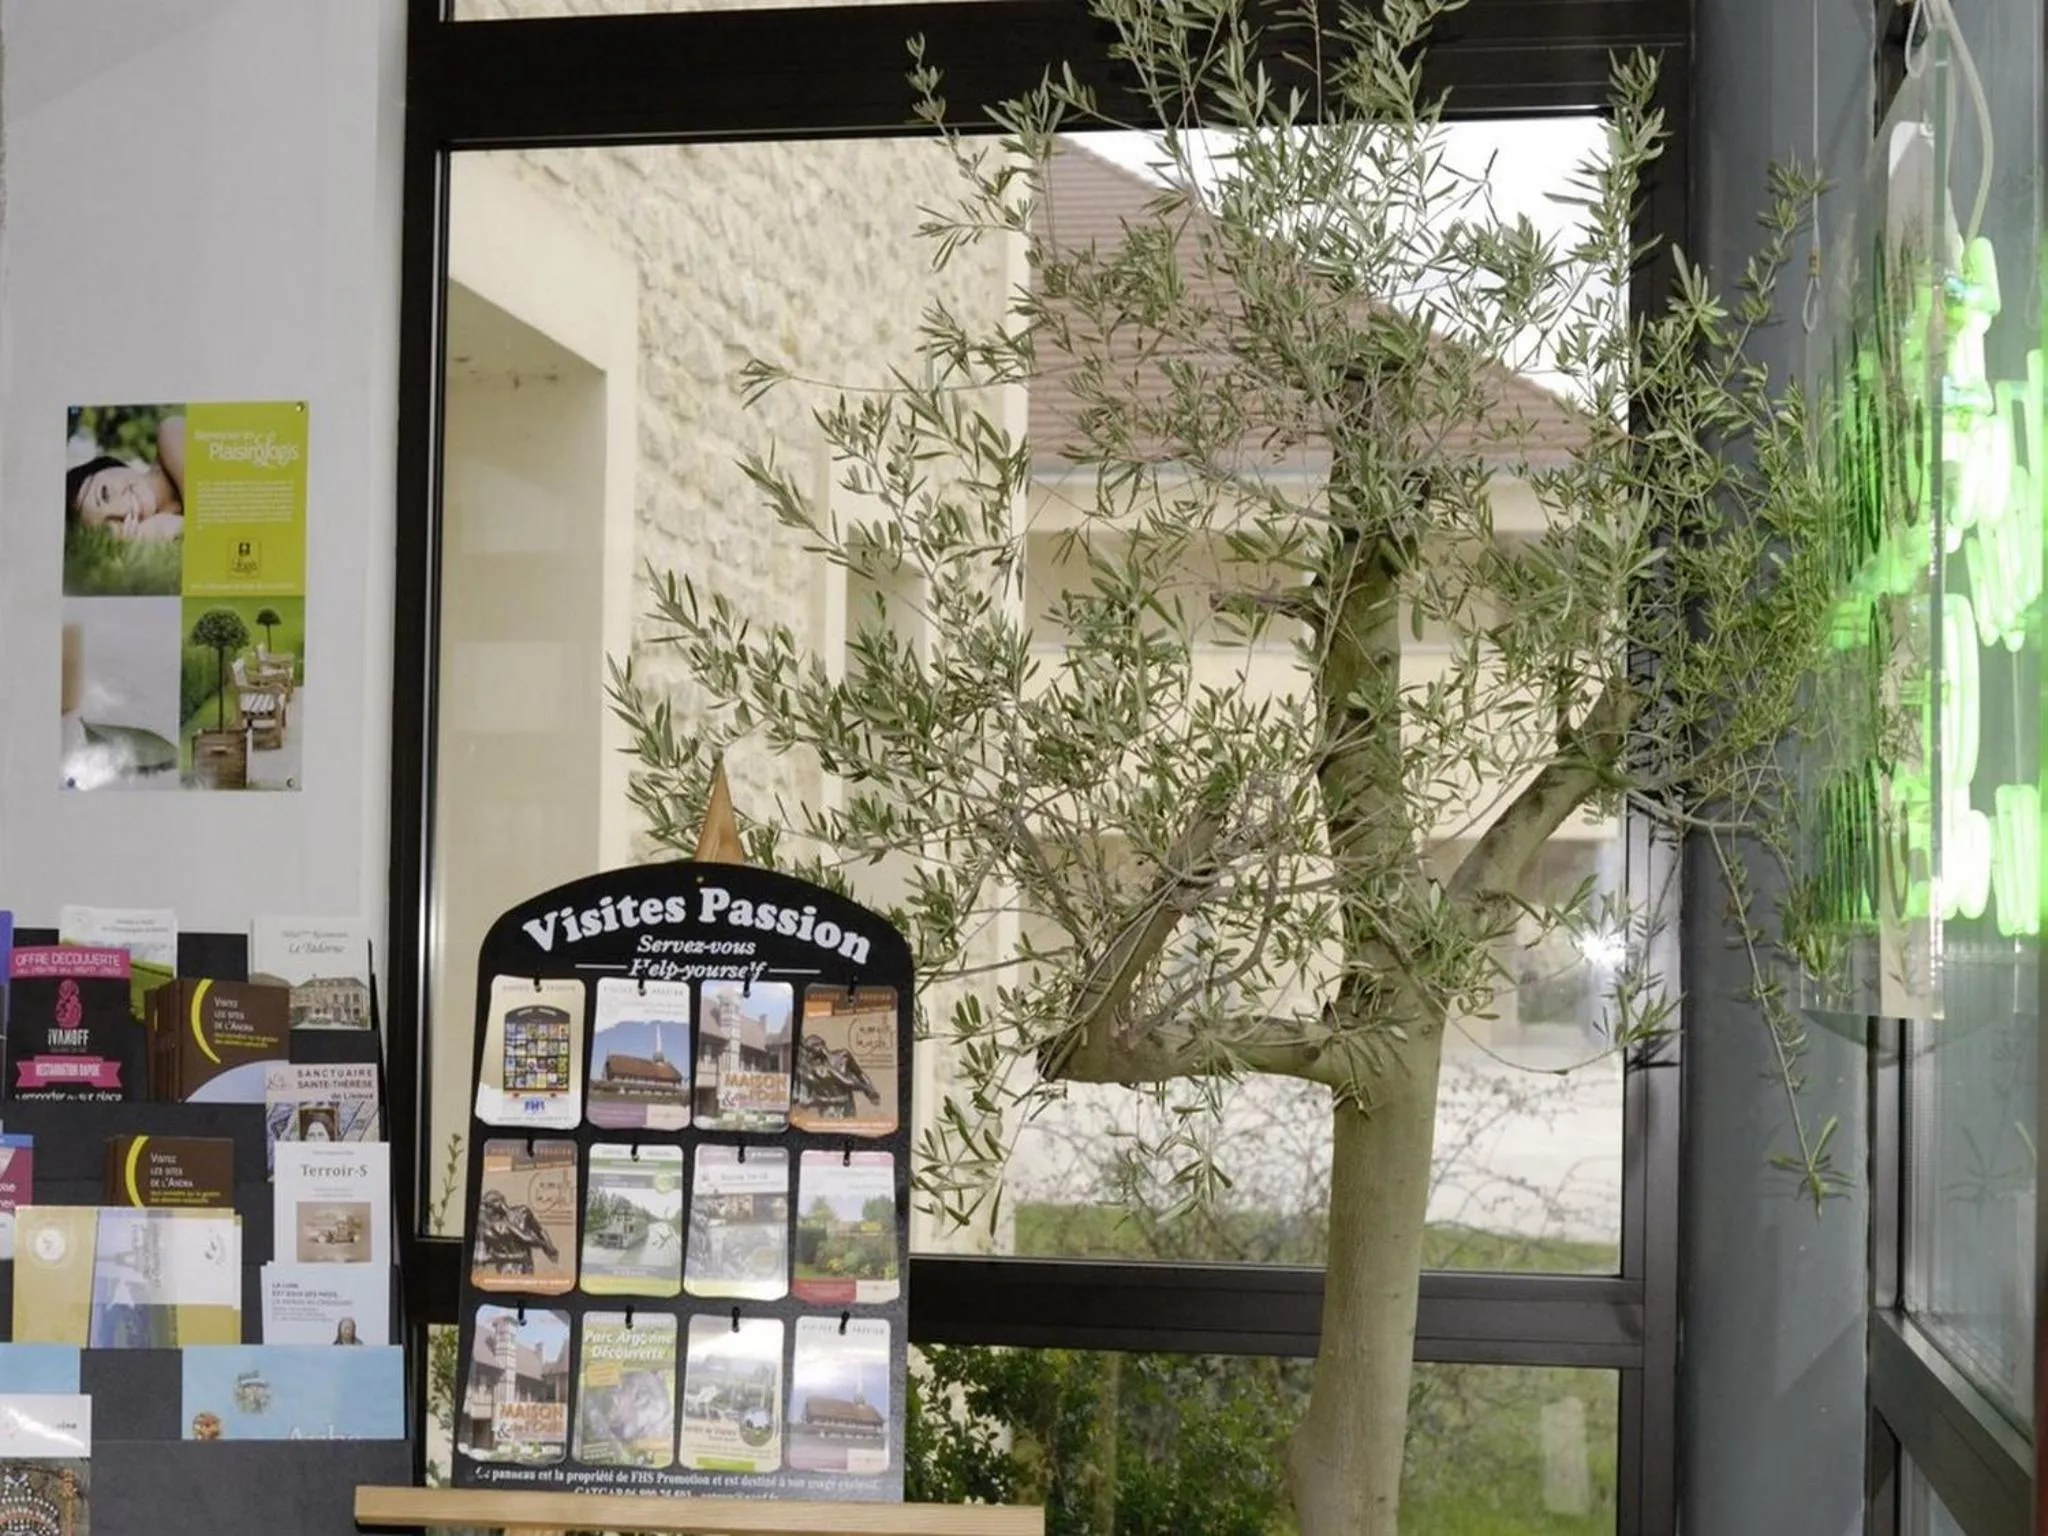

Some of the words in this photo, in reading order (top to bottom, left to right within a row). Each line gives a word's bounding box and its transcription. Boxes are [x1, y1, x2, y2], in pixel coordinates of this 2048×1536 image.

[523, 895, 686, 952] Visites
[697, 886, 872, 965] Passion
[637, 934, 757, 955] Servez-vous
[15, 952, 49, 966] OFFRE
[296, 1069, 373, 1079] SANCTUAIRE
[300, 1163, 369, 1178] Terroir-S
[492, 1468, 536, 1481] panneau
[538, 1469, 551, 1480] est
[554, 1468, 564, 1480] la
[566, 1469, 614, 1484] propriété
[616, 1471, 628, 1483] de
[656, 1472, 710, 1486] Promotion
[712, 1473, 723, 1486] et
[724, 1475, 739, 1487] est
[741, 1474, 777, 1487] destiné
